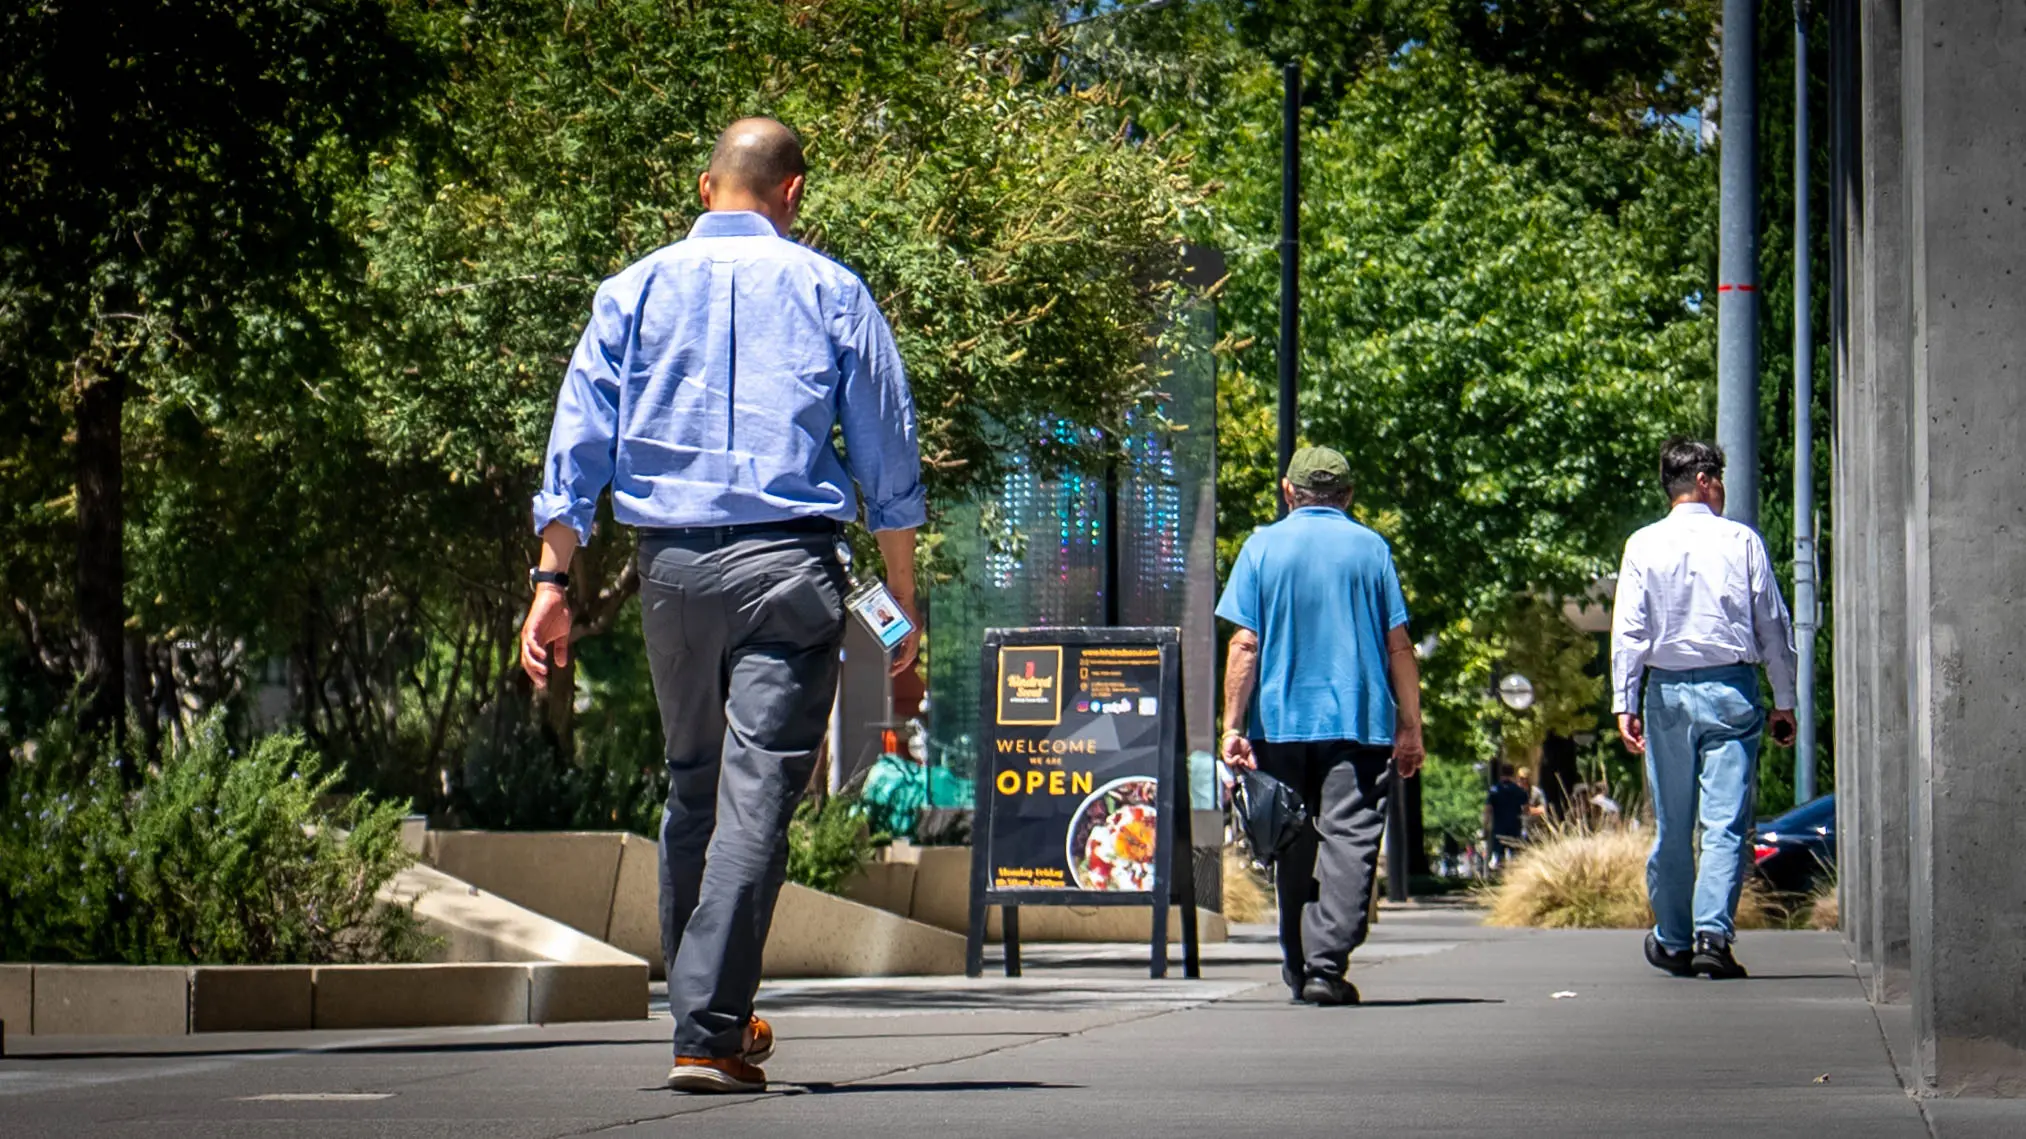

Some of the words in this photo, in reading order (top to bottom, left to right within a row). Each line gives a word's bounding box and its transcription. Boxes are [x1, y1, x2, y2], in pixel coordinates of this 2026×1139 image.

[996, 739, 1096, 754] WELCOME
[1029, 757, 1042, 765] WE
[1045, 757, 1062, 765] ARE
[996, 769, 1092, 795] OPEN
